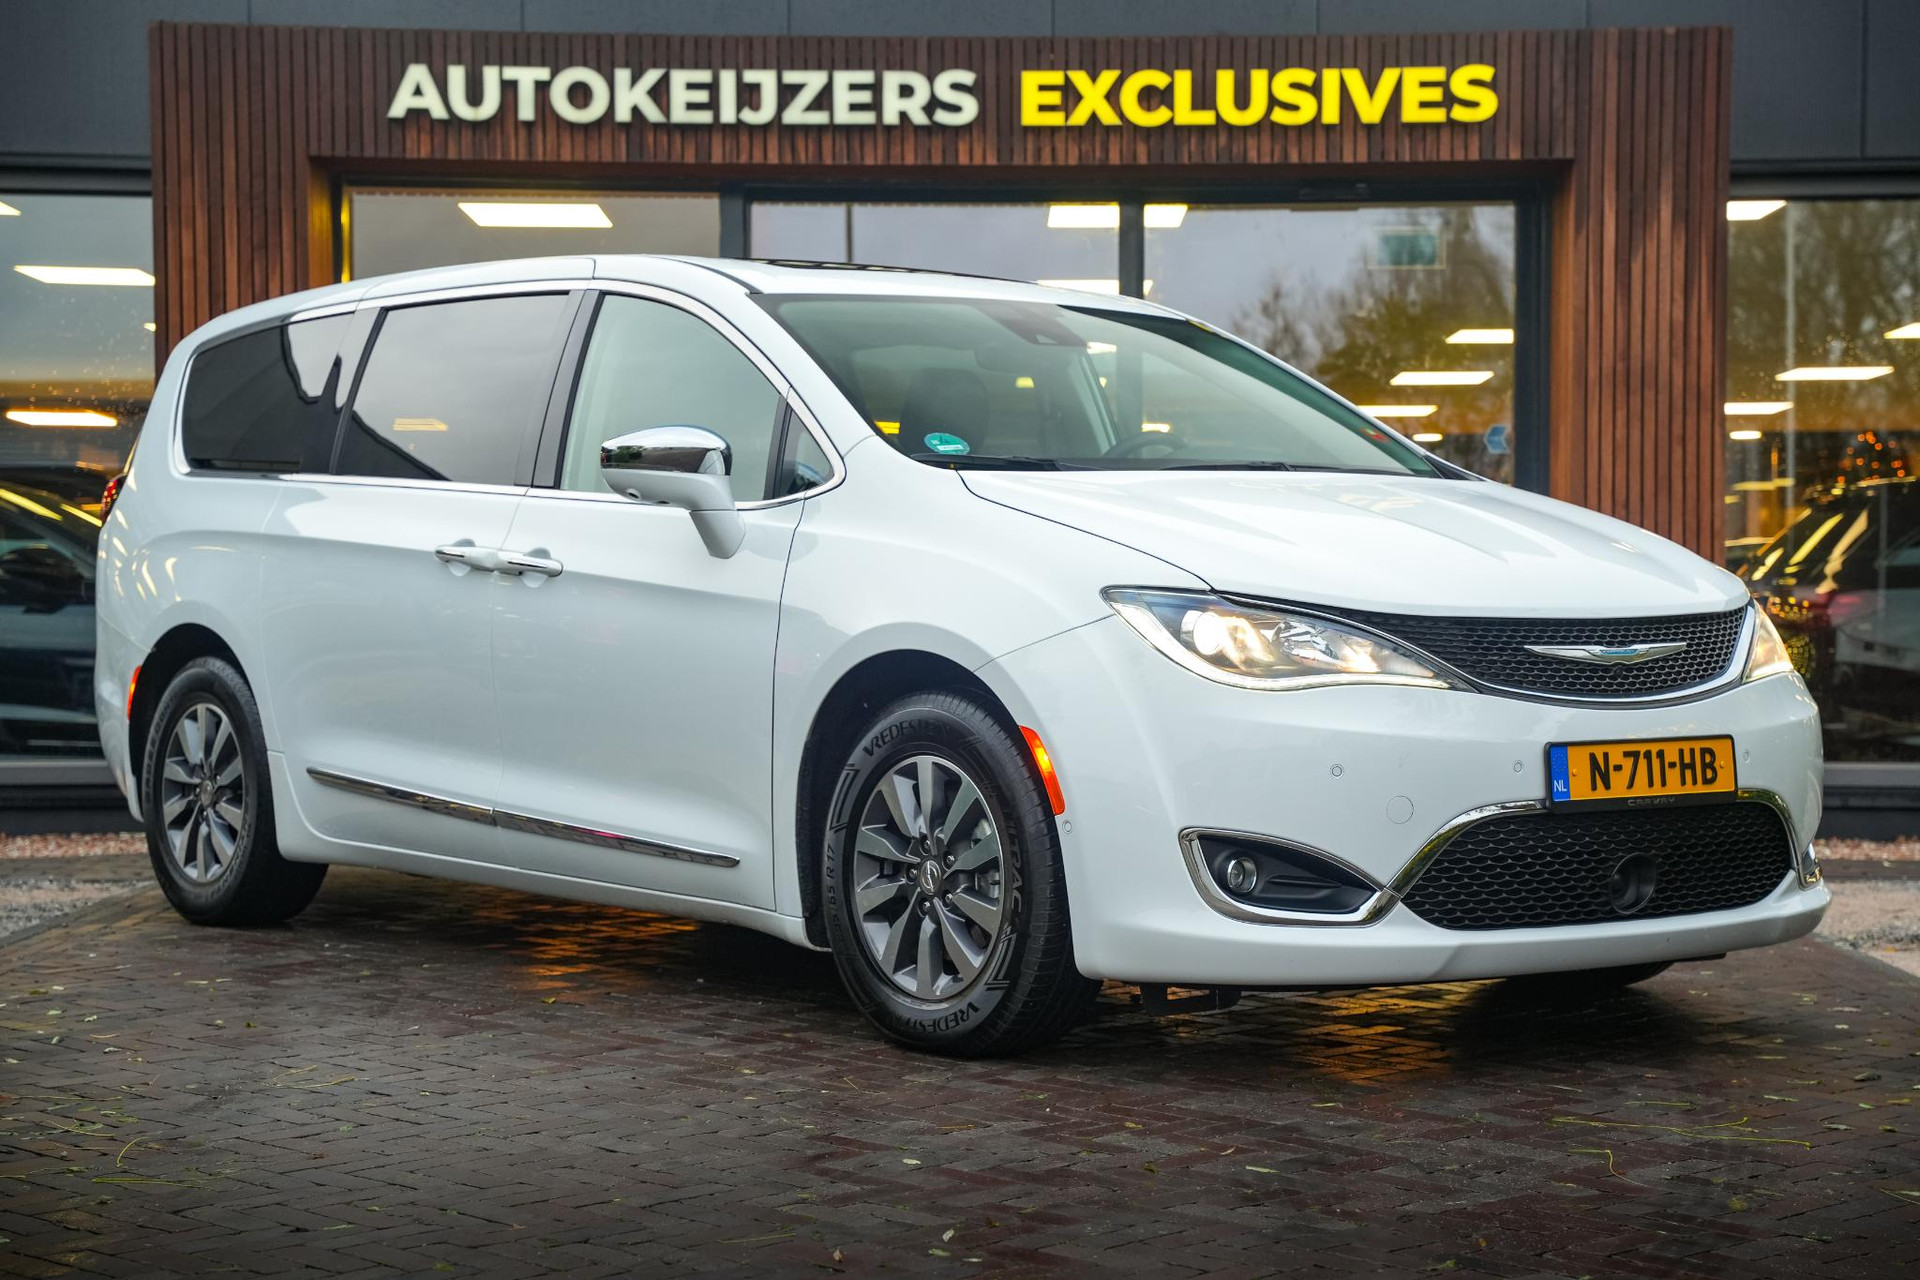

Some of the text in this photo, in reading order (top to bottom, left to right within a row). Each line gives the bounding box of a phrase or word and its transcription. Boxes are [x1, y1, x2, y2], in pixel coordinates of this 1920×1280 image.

[387, 63, 1500, 128] AUTOKEIJZERS EXCLUSIVES
[1553, 779, 1568, 792] NL
[1588, 747, 1718, 791] N-711-HB
